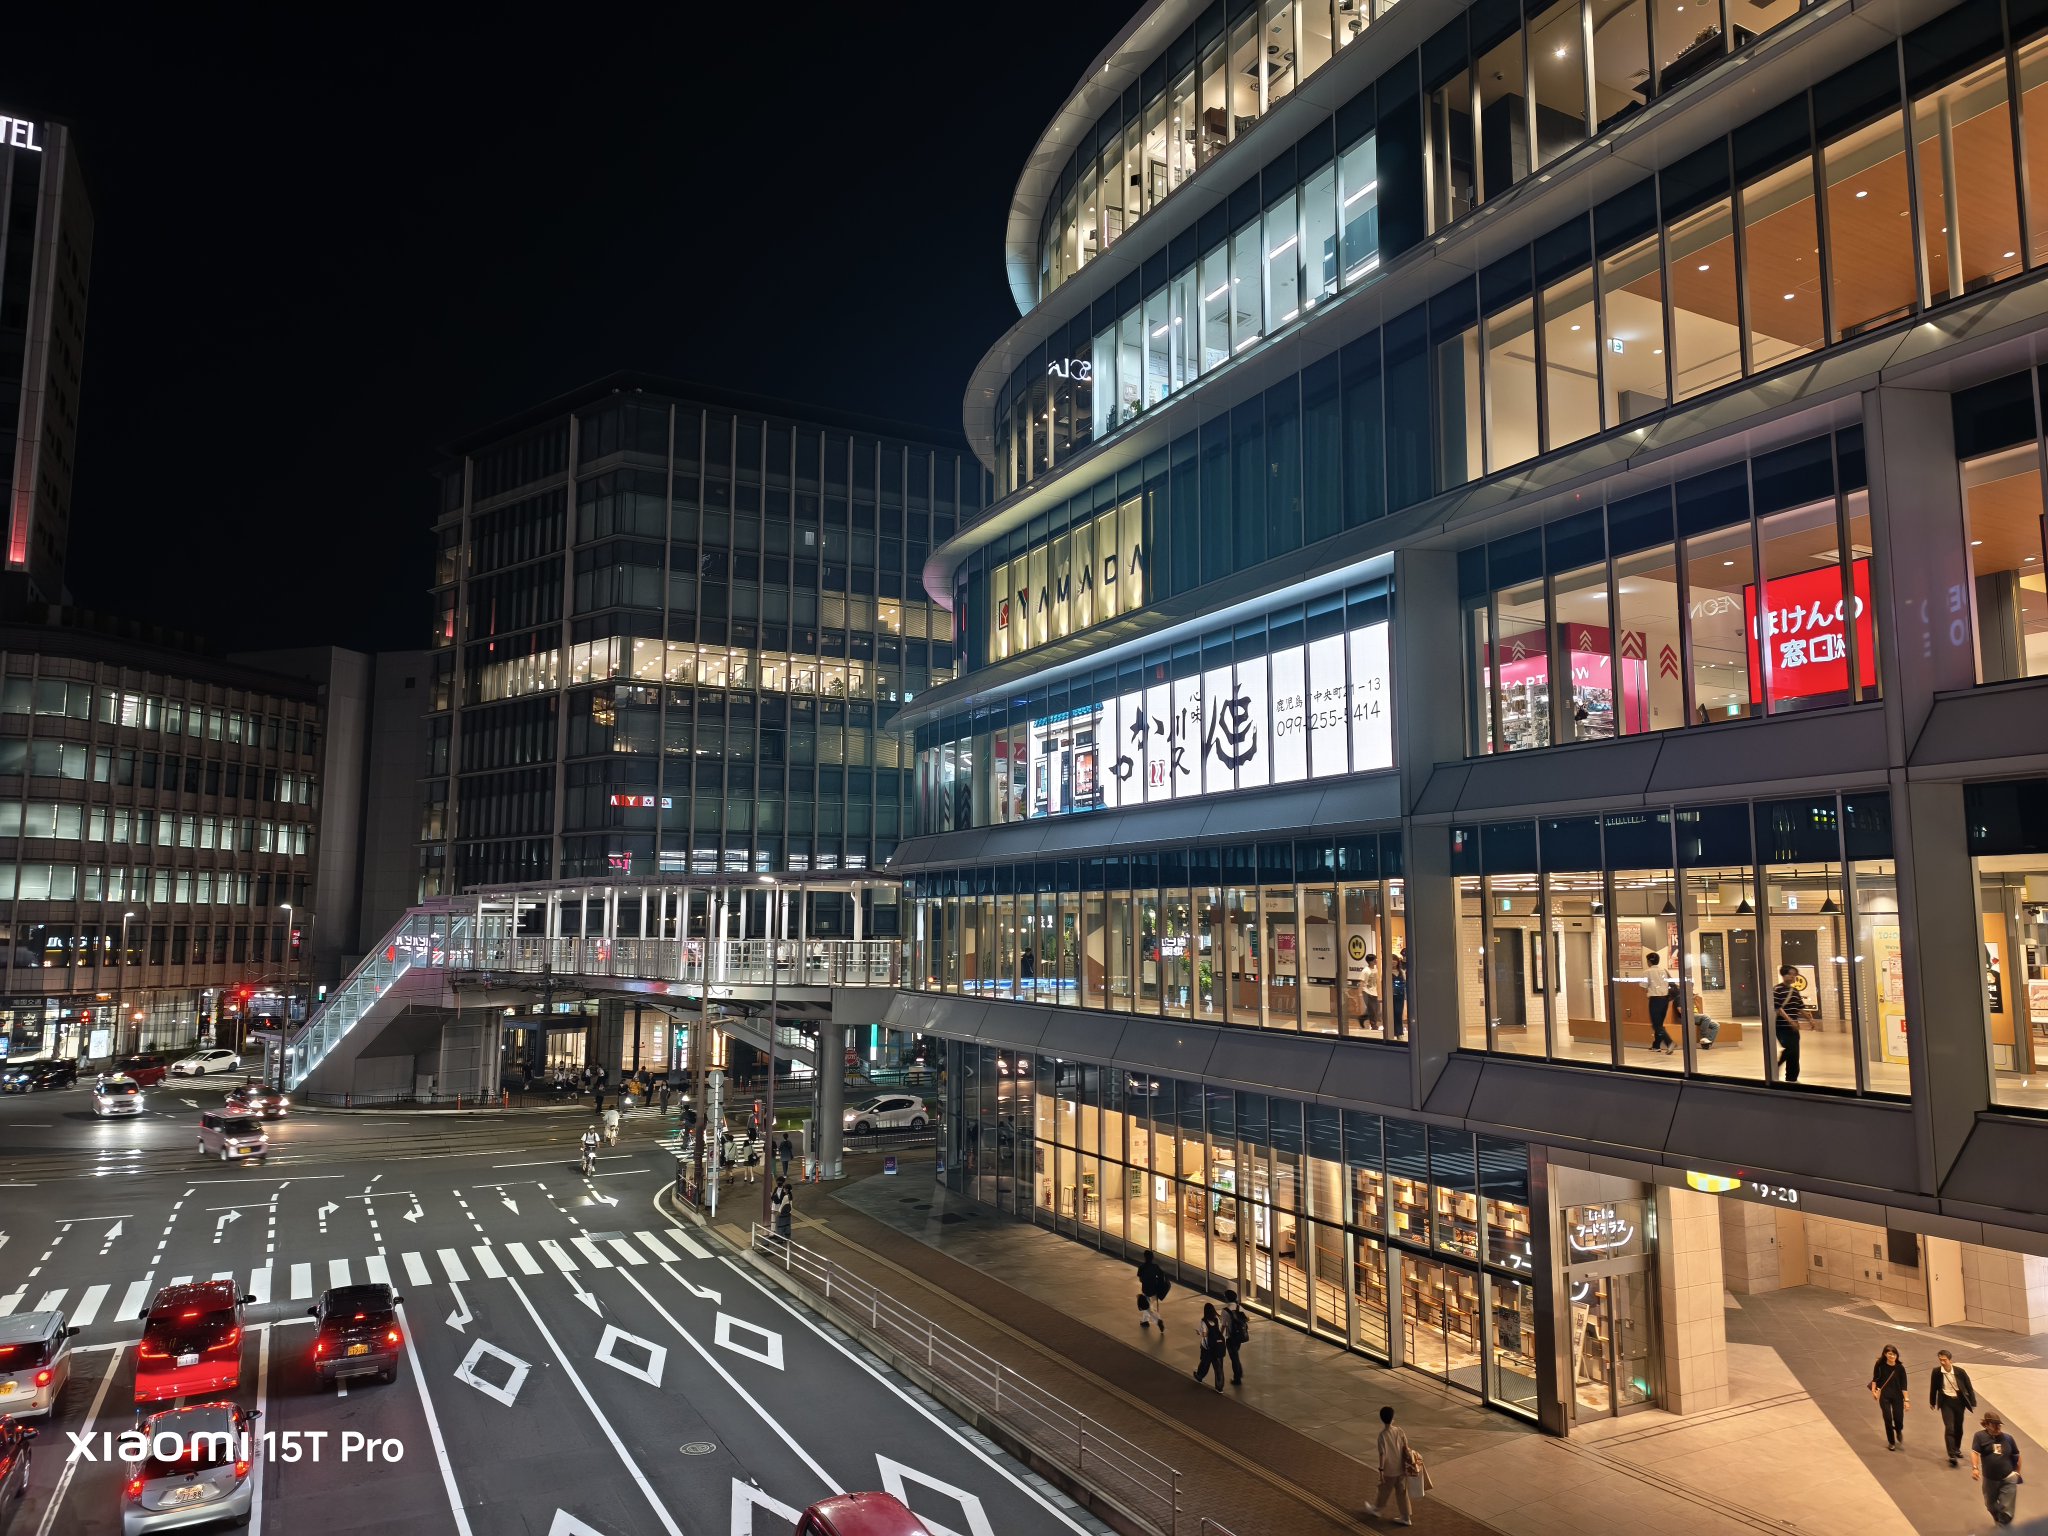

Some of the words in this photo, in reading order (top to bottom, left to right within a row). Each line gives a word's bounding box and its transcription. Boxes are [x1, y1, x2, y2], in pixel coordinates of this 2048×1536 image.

[1017, 543, 1143, 620] YAMADA
[1753, 596, 1863, 639] ほけんの
